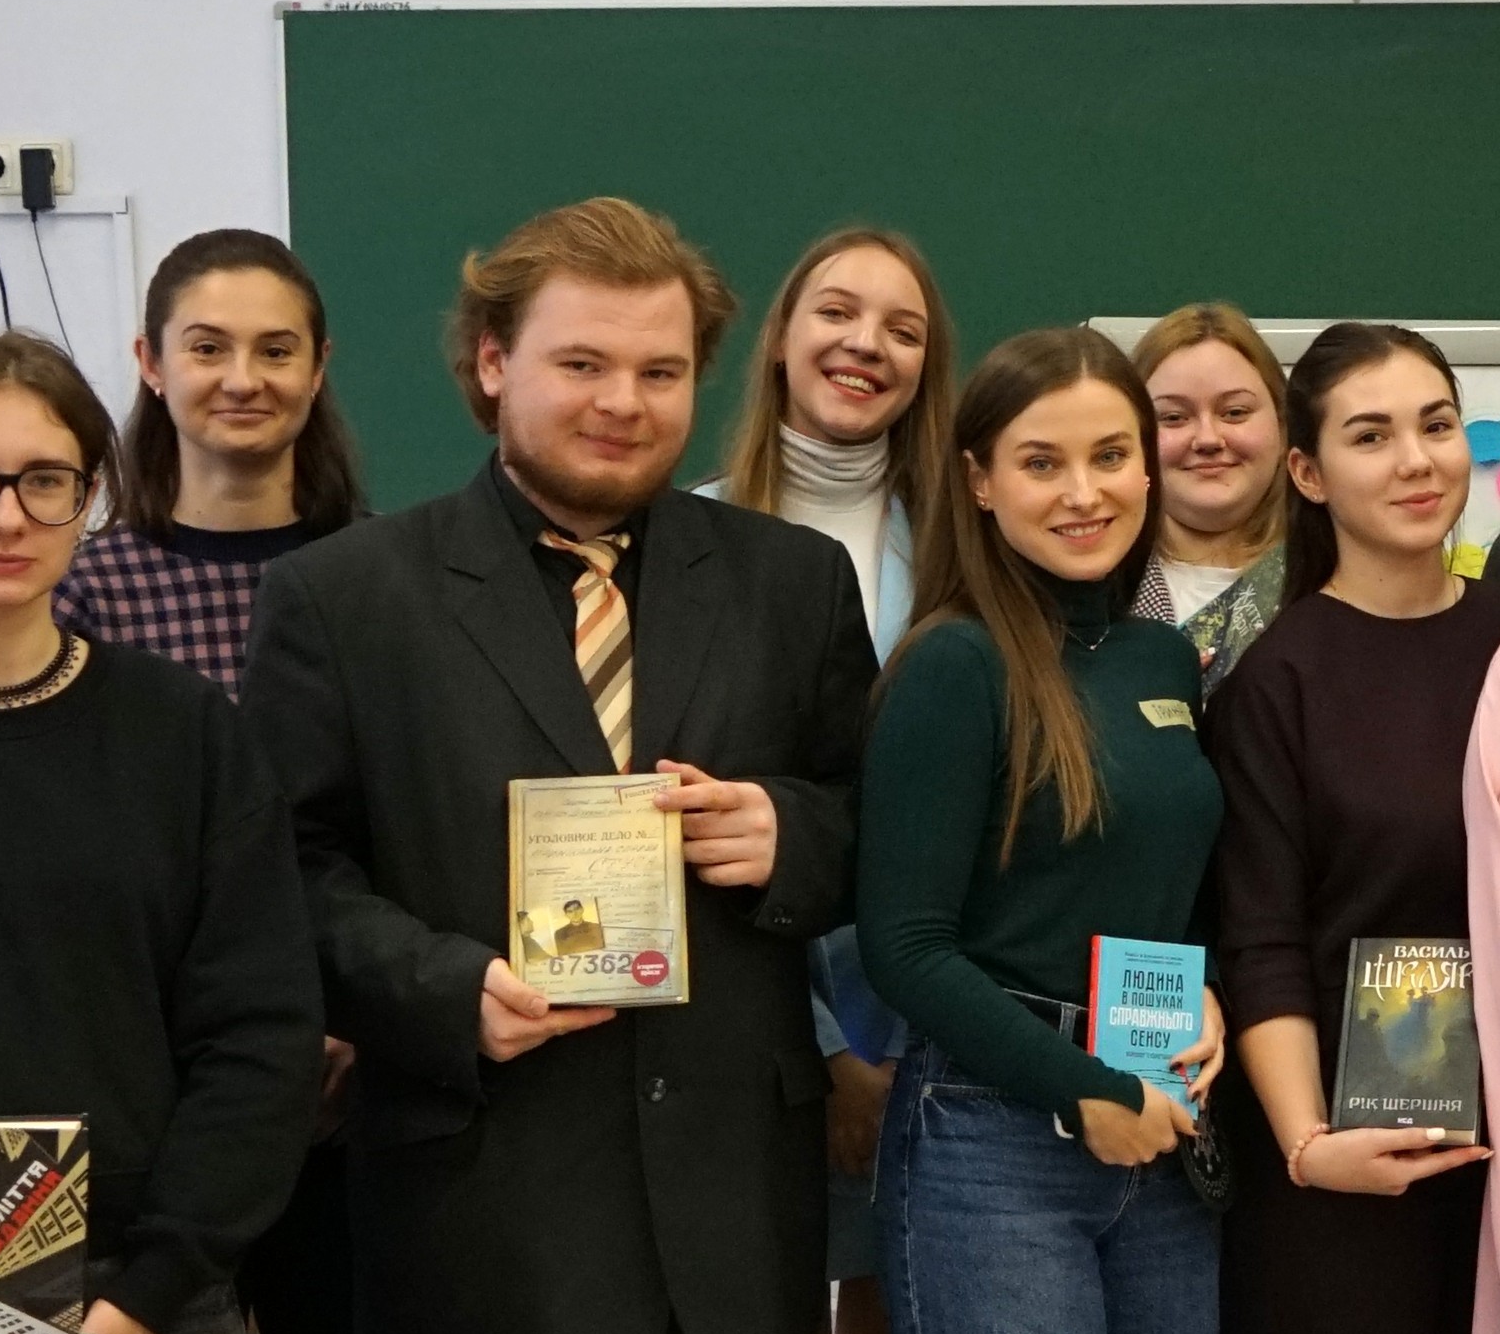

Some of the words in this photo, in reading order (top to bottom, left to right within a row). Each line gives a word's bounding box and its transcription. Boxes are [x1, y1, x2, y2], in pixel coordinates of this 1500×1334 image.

[528, 832, 597, 844] УГОЛОВНОЕ
[601, 831, 632, 841] ДЕЛО
[1394, 945, 1471, 959] ВАСИЛЬ
[550, 954, 633, 976] 67362
[1122, 969, 1184, 993] ЛЮДИНА
[1361, 953, 1474, 1002] ШКЛЯР
[1122, 991, 1128, 1005] В
[1132, 992, 1183, 1009] ПОШУКАХ
[1110, 1006, 1193, 1031] СПРАВЖНЬОГО
[1131, 1030, 1171, 1049] СЕНСУ
[1349, 1097, 1378, 1110] РІК
[1382, 1098, 1462, 1112] ШЕРШНЯ
